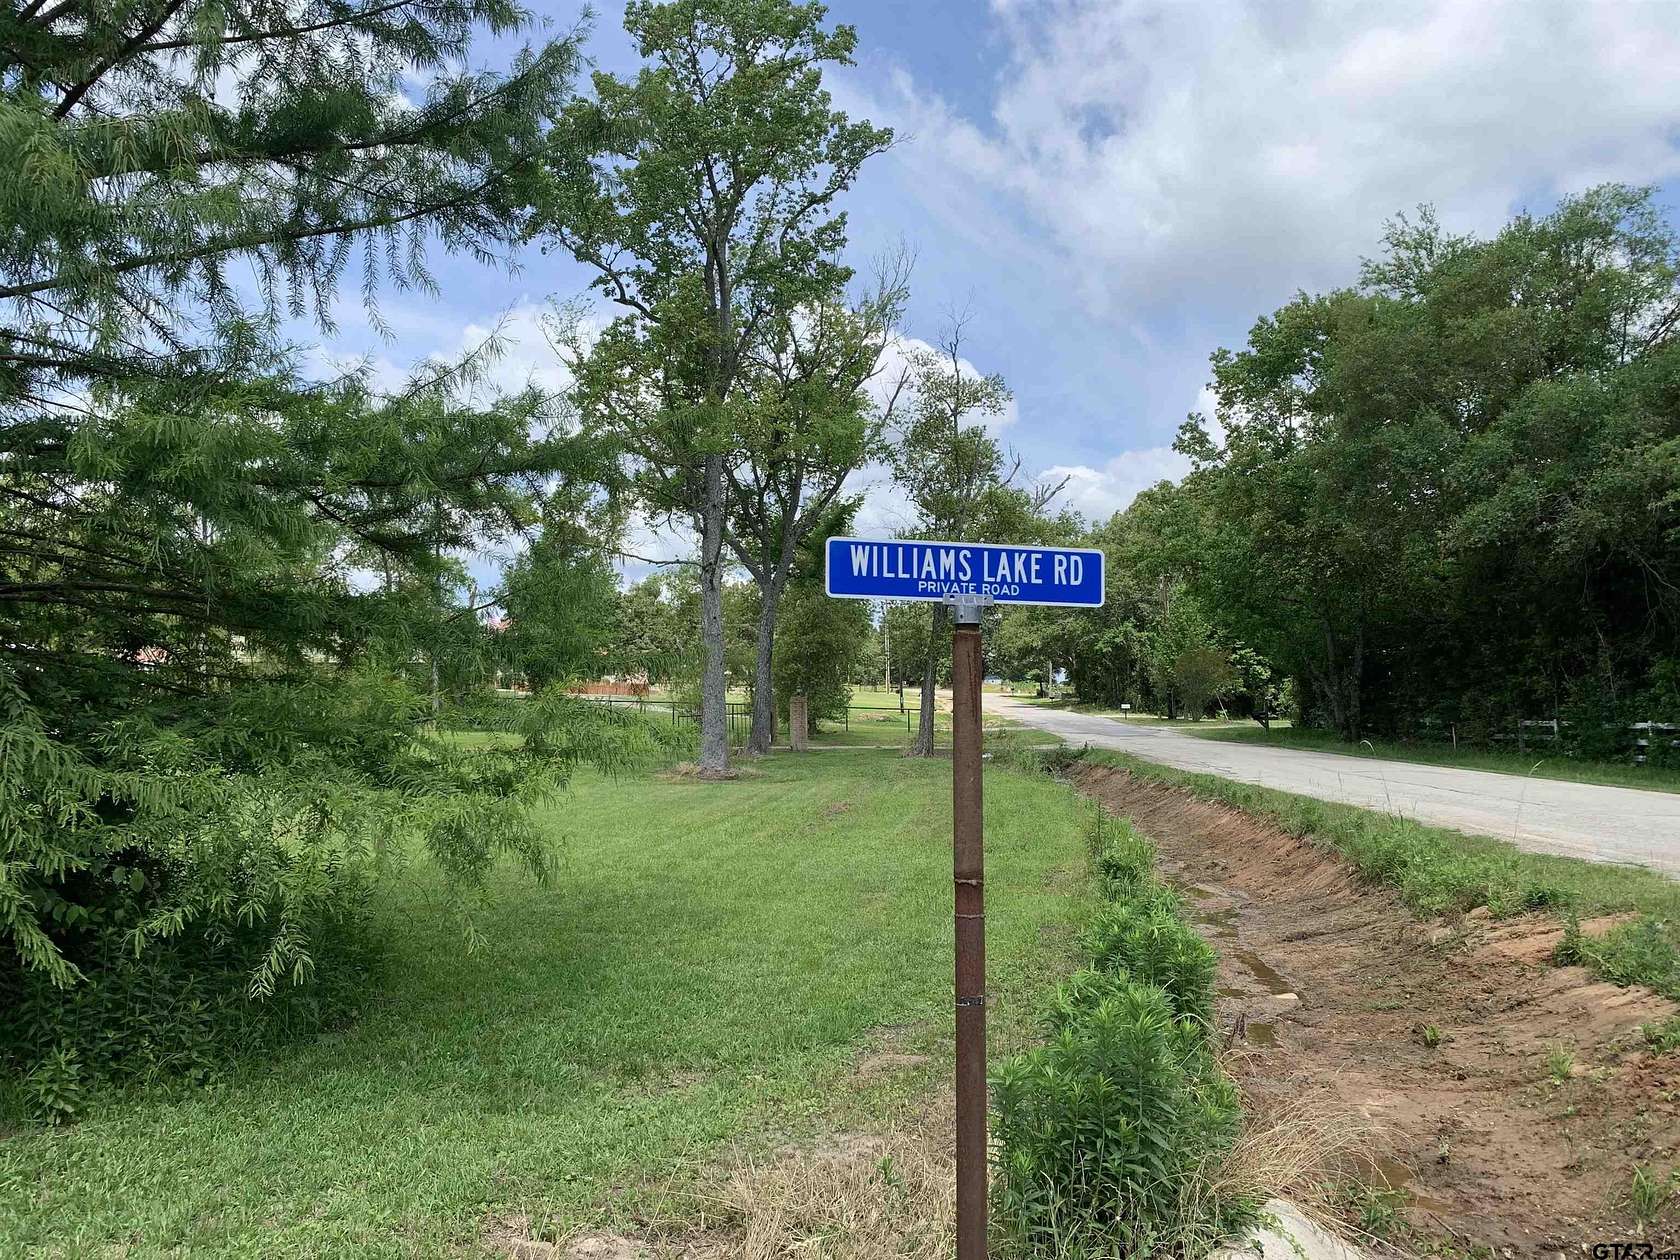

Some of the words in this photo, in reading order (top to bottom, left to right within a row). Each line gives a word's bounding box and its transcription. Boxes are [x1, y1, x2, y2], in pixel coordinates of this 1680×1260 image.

[850, 544, 972, 581] WILLIAMS
[983, 551, 1043, 584] LAKE
[1054, 554, 1084, 586] RD
[918, 581, 977, 594] PRIVATE
[982, 584, 1020, 596] ROAD
